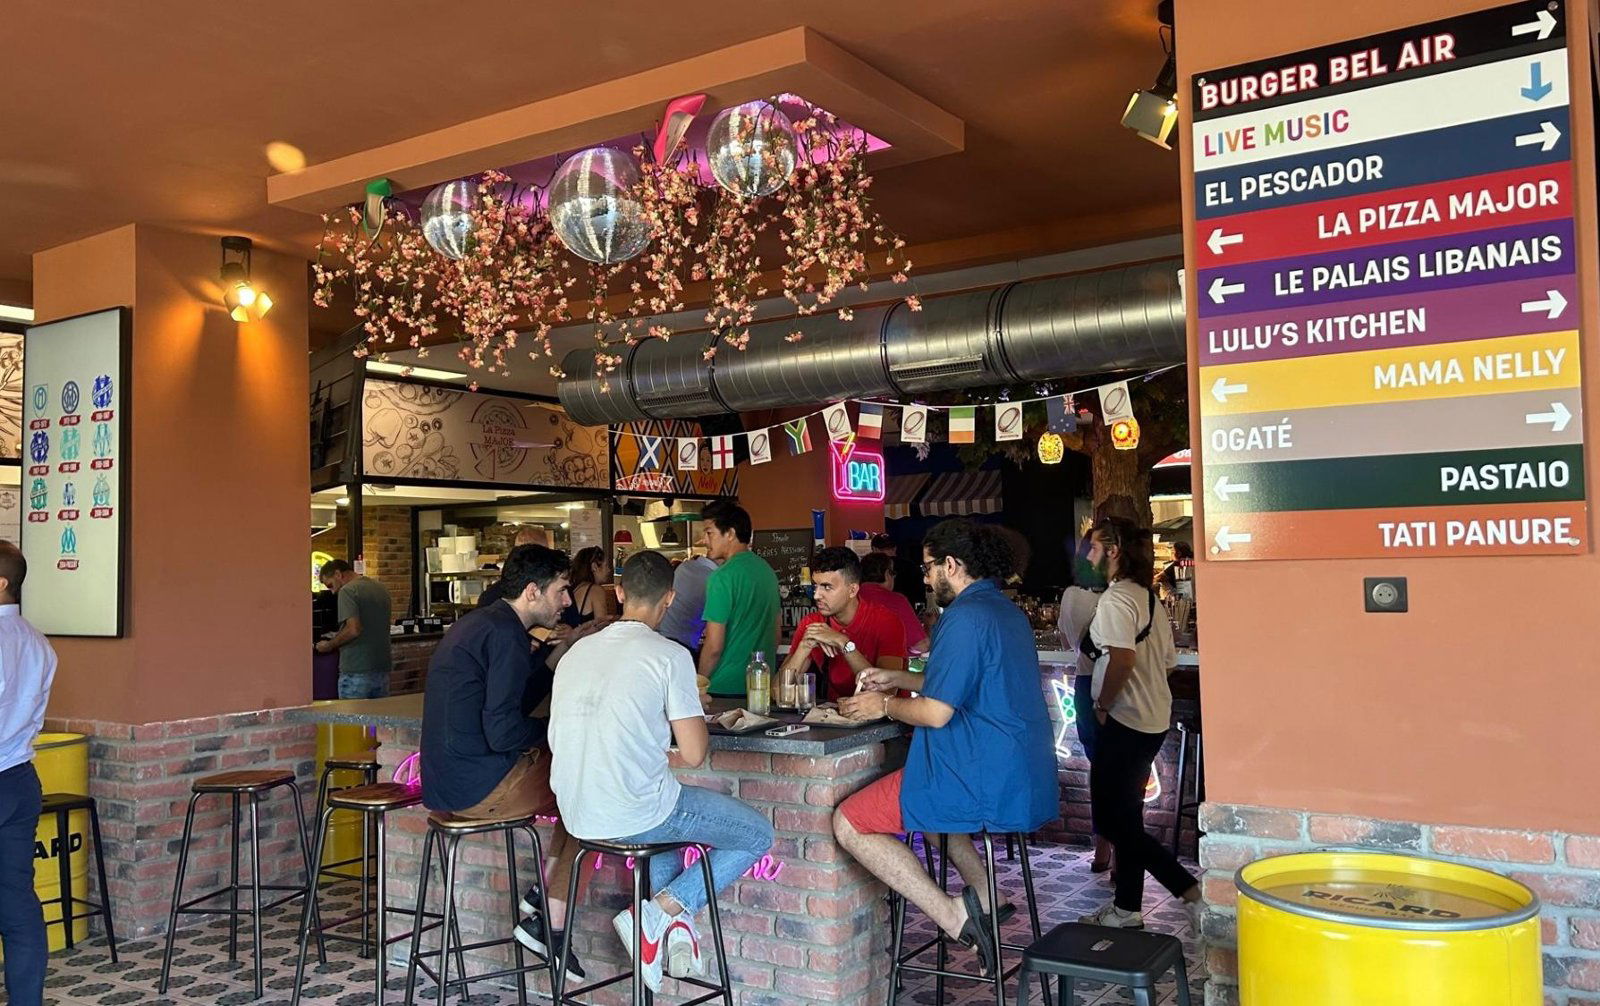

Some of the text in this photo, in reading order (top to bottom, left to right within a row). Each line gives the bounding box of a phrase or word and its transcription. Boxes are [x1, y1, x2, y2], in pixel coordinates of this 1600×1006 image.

[1201, 32, 1456, 110] BURGER BEL AIR
[1204, 109, 1350, 157] LIVE MUSIC
[1205, 155, 1384, 207] EL PESCADOR
[1317, 180, 1559, 240] LA PIZZA MAJOR
[1274, 235, 1562, 296] LE PALAIS LIBANAIS
[1209, 308, 1426, 354] LULU'S KITCHEN
[1373, 348, 1566, 389] MAMA NELLY
[1211, 418, 1293, 452] OGATÉ
[850, 461, 880, 492] BAR
[1440, 460, 1570, 491] PASTAIO
[1378, 518, 1572, 547] TATI PANURE
[1305, 889, 1461, 917] RICARD
